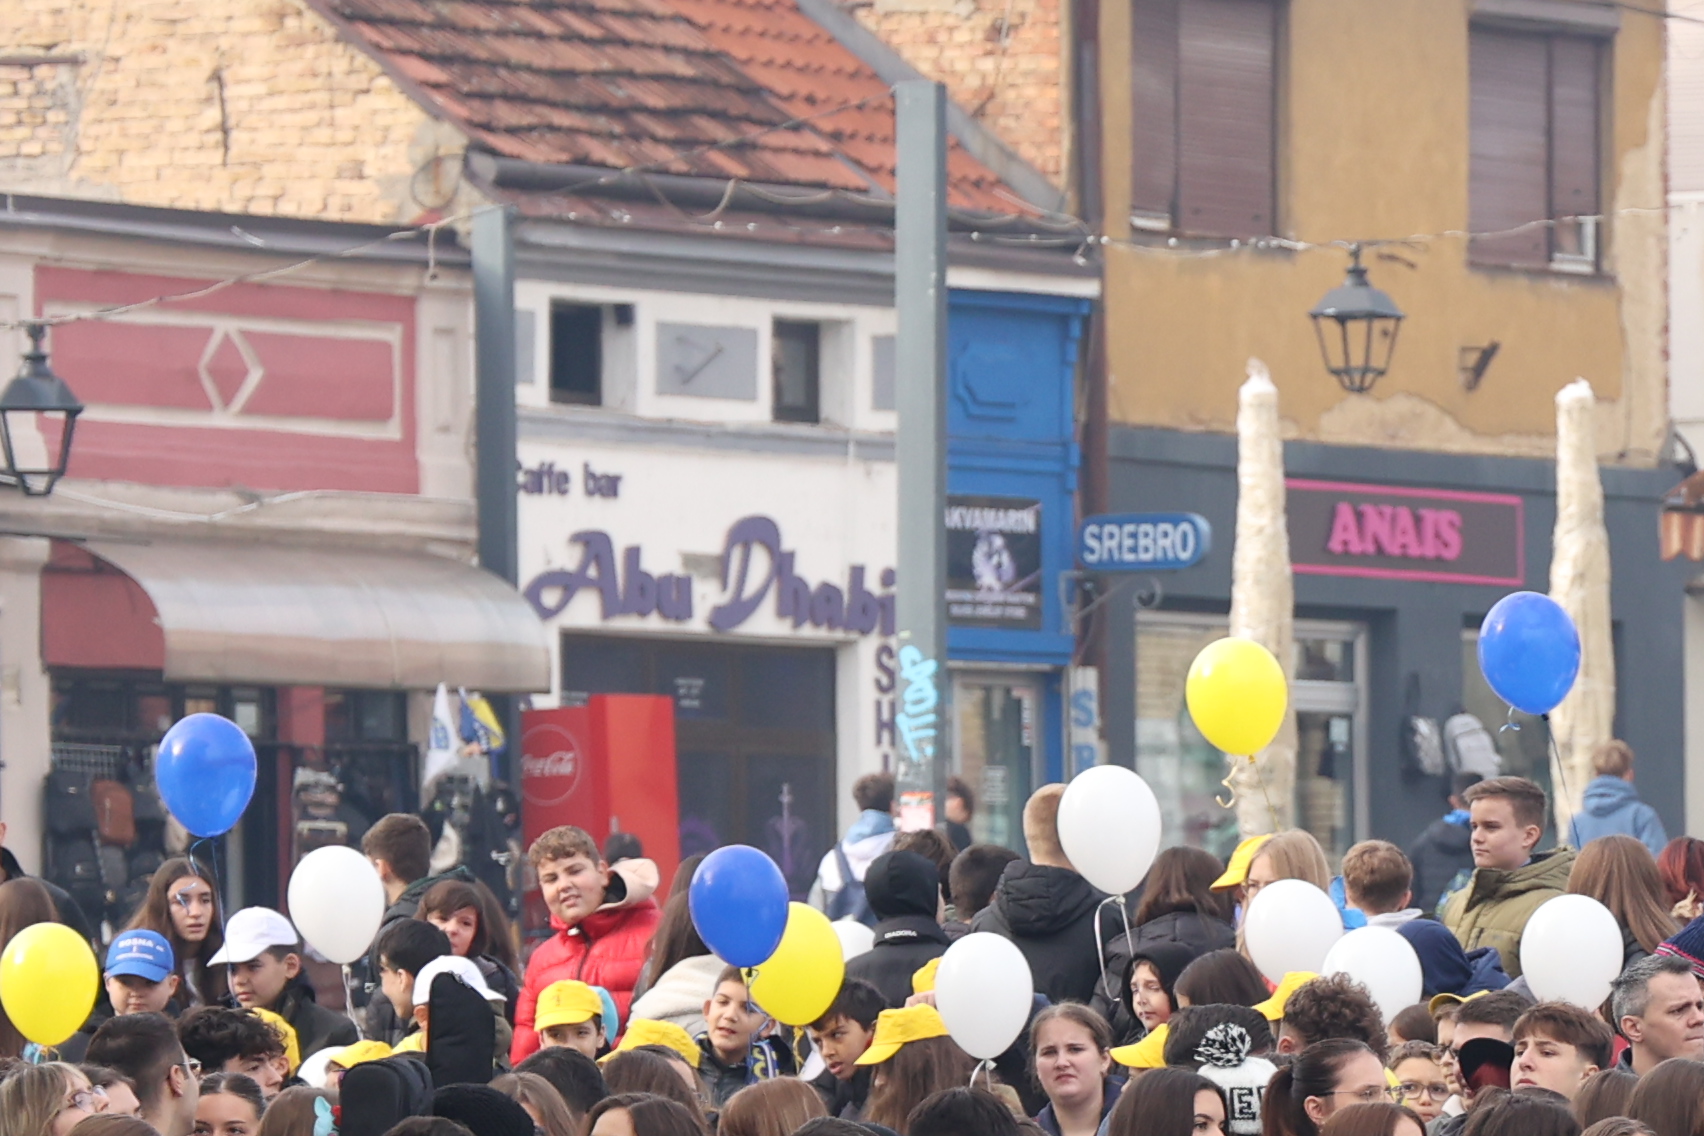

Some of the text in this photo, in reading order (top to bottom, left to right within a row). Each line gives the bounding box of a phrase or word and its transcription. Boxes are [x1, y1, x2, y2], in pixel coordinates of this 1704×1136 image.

[582, 461, 623, 499] bar
[1082, 521, 1196, 564] SREBRO
[1327, 501, 1463, 561] ANAIS
[522, 515, 897, 637] Abu Dhabi
